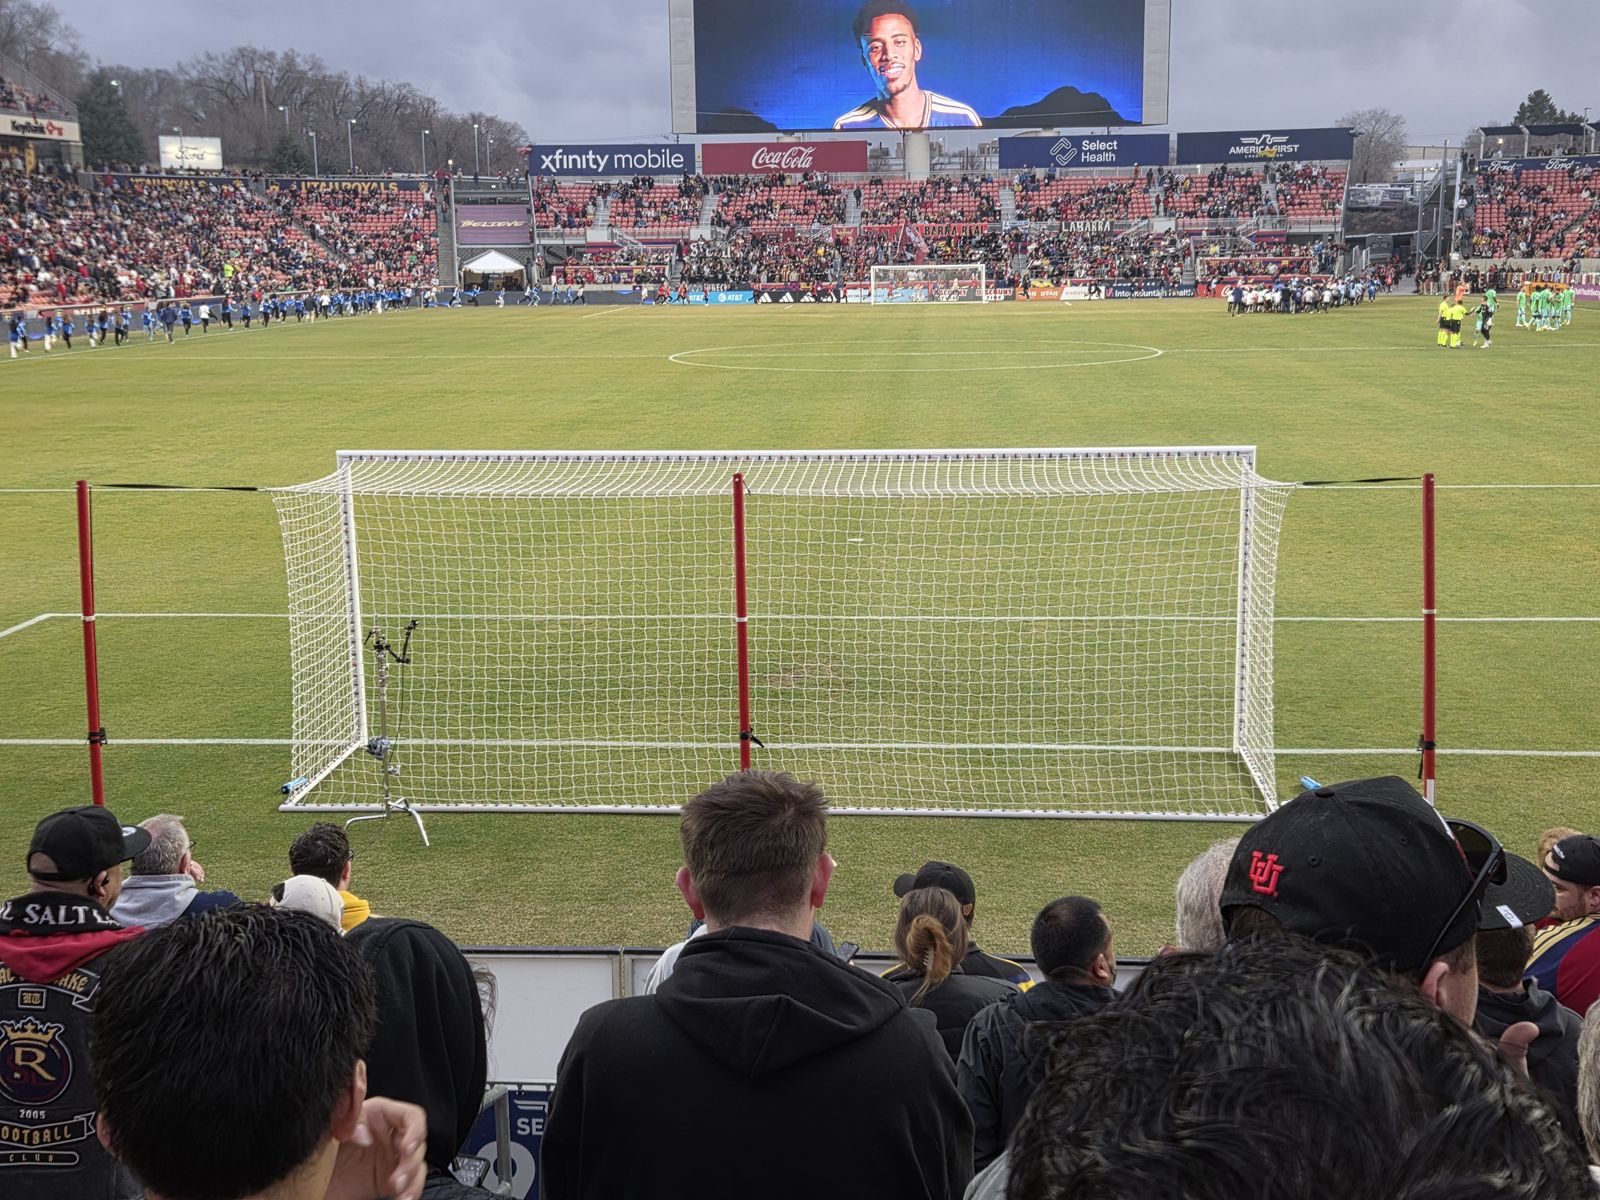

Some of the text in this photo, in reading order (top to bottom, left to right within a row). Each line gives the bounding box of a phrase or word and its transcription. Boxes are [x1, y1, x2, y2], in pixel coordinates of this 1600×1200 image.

[1082, 140, 1118, 150] Select
[1229, 145, 1270, 155] AMERICA
[541, 149, 684, 172] xfinity mobile
[751, 146, 817, 170] Coca-Cola
[1081, 152, 1116, 162] Health
[1545, 157, 1575, 170] Ford
[1488, 160, 1517, 172] Ford
[23, 903, 89, 925] SALT
[58, 973, 88, 993] AKE
[19, 1109, 46, 1119] 2005
[517, 1117, 544, 1136] SE
[0, 1125, 72, 1145] OOTBALL
